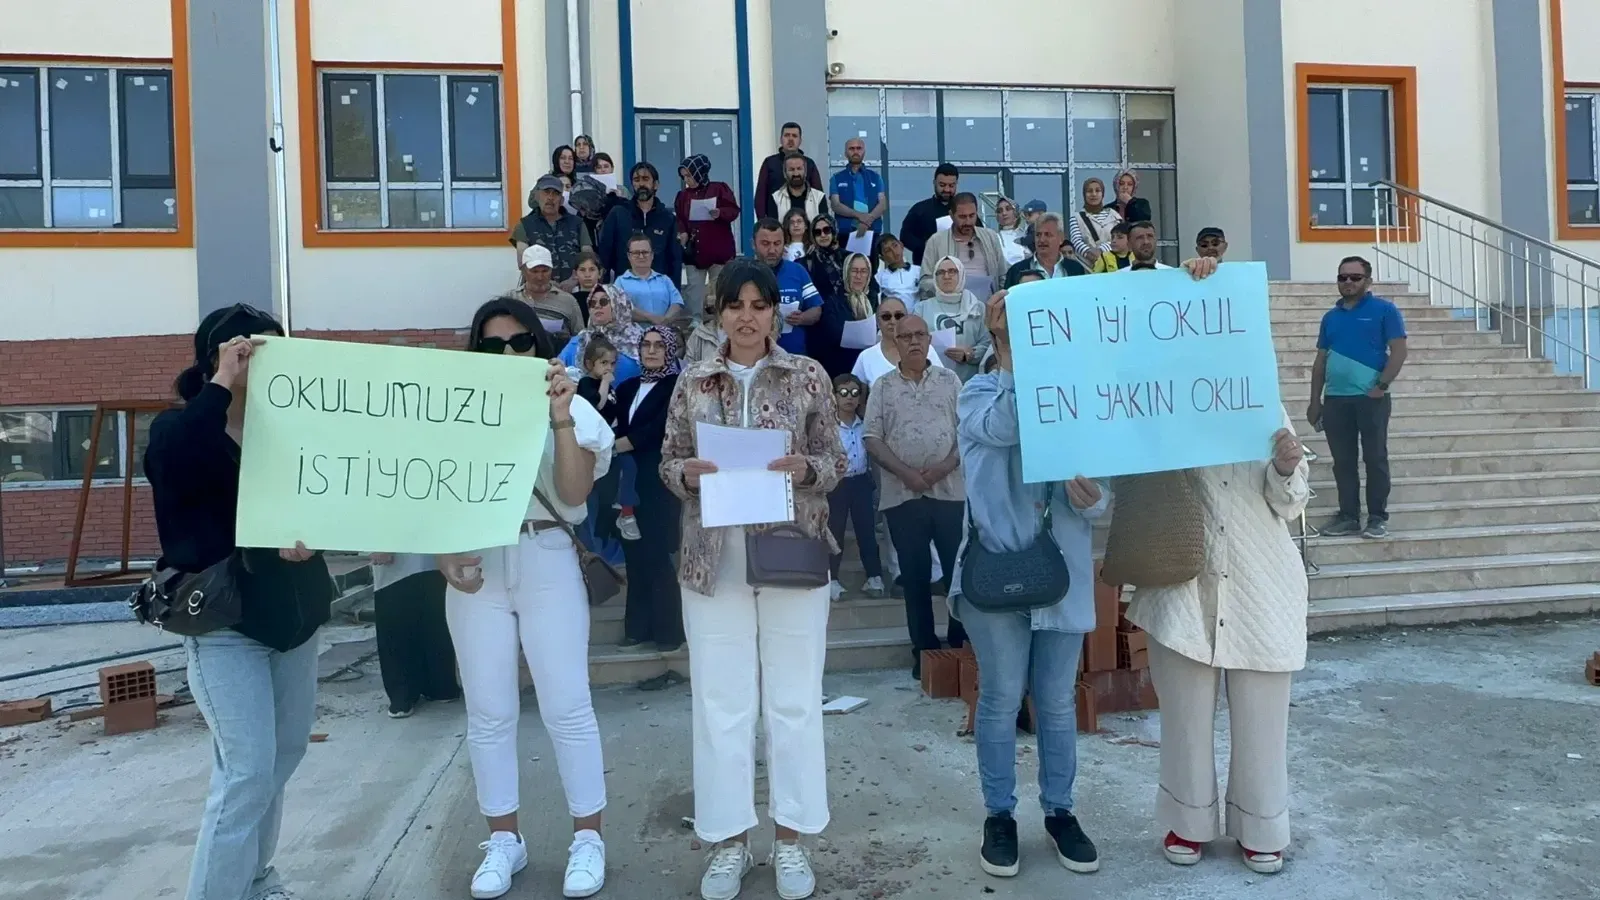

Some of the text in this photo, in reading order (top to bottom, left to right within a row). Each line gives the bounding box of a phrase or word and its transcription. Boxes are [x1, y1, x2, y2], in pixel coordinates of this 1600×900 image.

[1028, 297, 1246, 346] EN İYİ OKUL
[268, 374, 503, 426] OKULUMUZU
[1036, 376, 1264, 423] EN YAKIN OKUL
[297, 447, 516, 503] İSTİYORUZ
